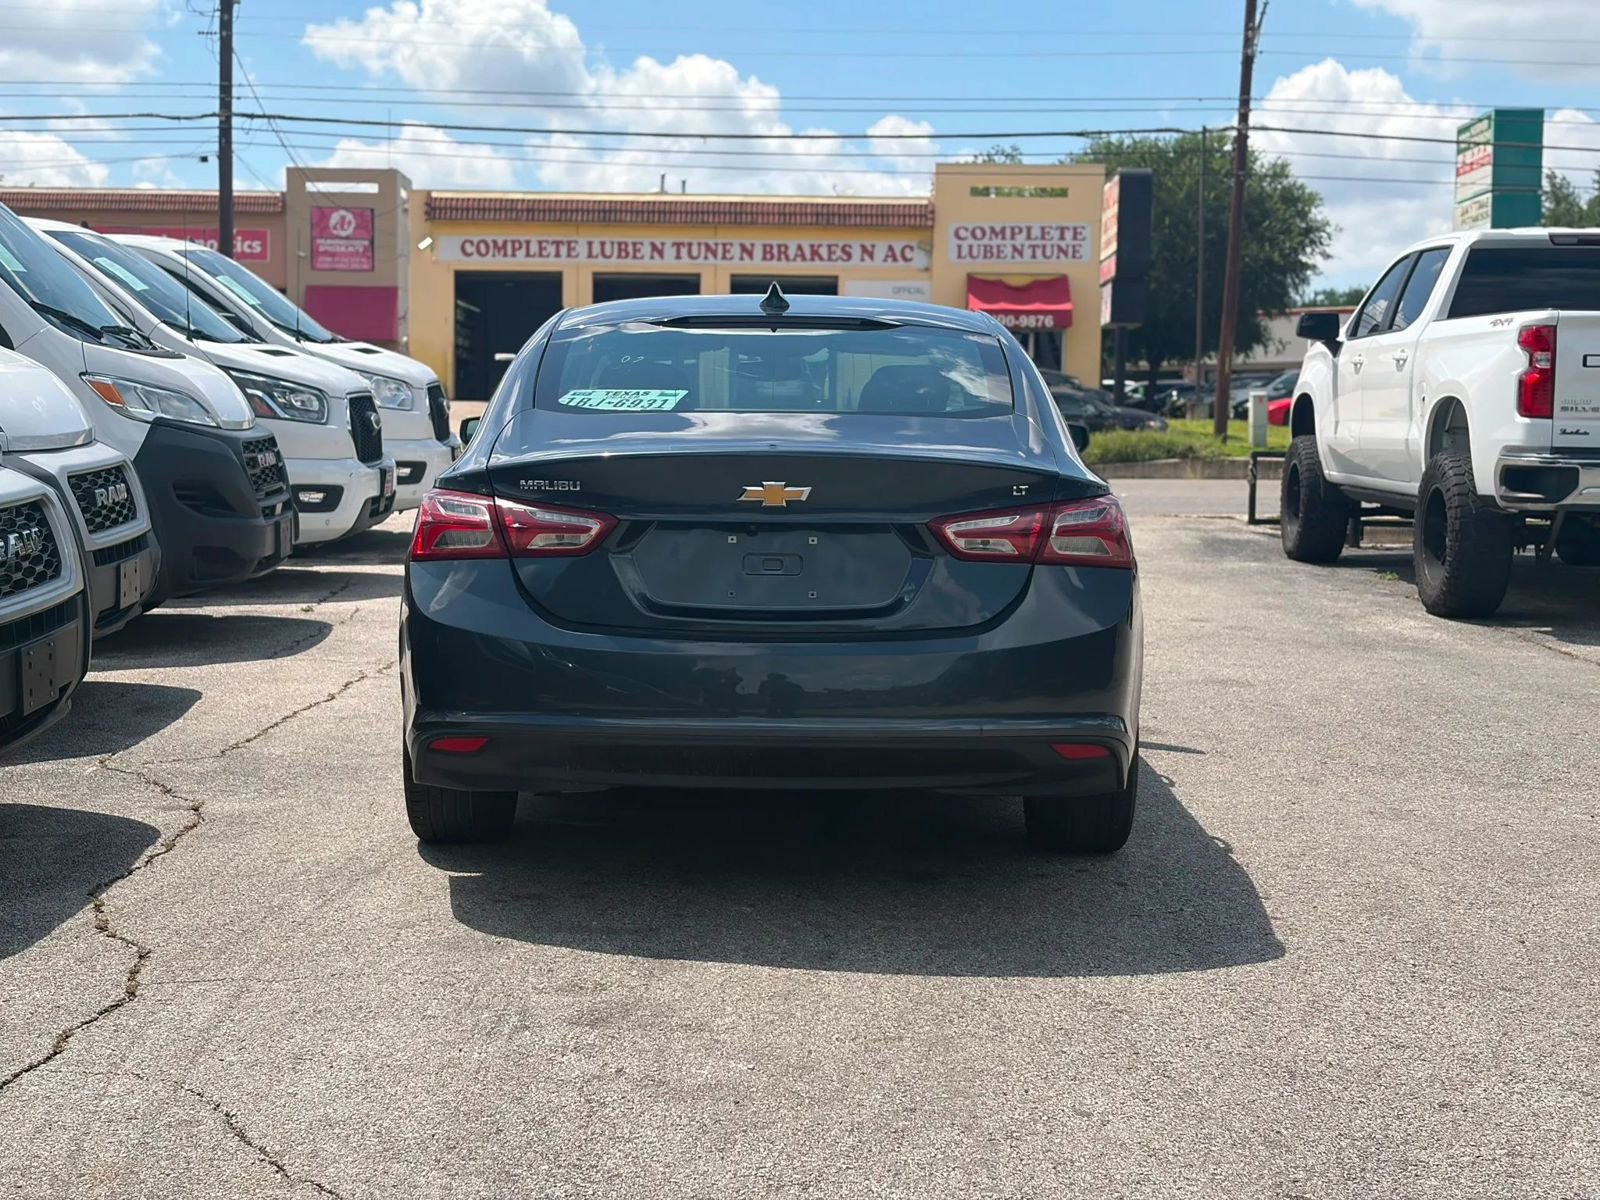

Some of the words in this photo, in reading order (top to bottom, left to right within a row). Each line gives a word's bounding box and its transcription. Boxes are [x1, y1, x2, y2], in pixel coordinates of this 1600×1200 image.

[954, 225, 1087, 241] COMPLETE
[460, 239, 579, 258] COMPLETE
[586, 240, 645, 260] LUBE
[650, 241, 666, 260] N
[671, 241, 734, 261] TUNE
[739, 242, 756, 261] N
[761, 242, 853, 263] BRAKES
[860, 243, 876, 263] N
[883, 243, 915, 263] AC
[956, 243, 1008, 260] LUBE
[1010, 243, 1025, 260] N
[1028, 243, 1084, 260] TUNE
[993, 313, 1055, 328] 90-9876
[520, 480, 581, 491] MALIBU
[1013, 485, 1029, 496] LT
[95, 483, 129, 507] RAM
